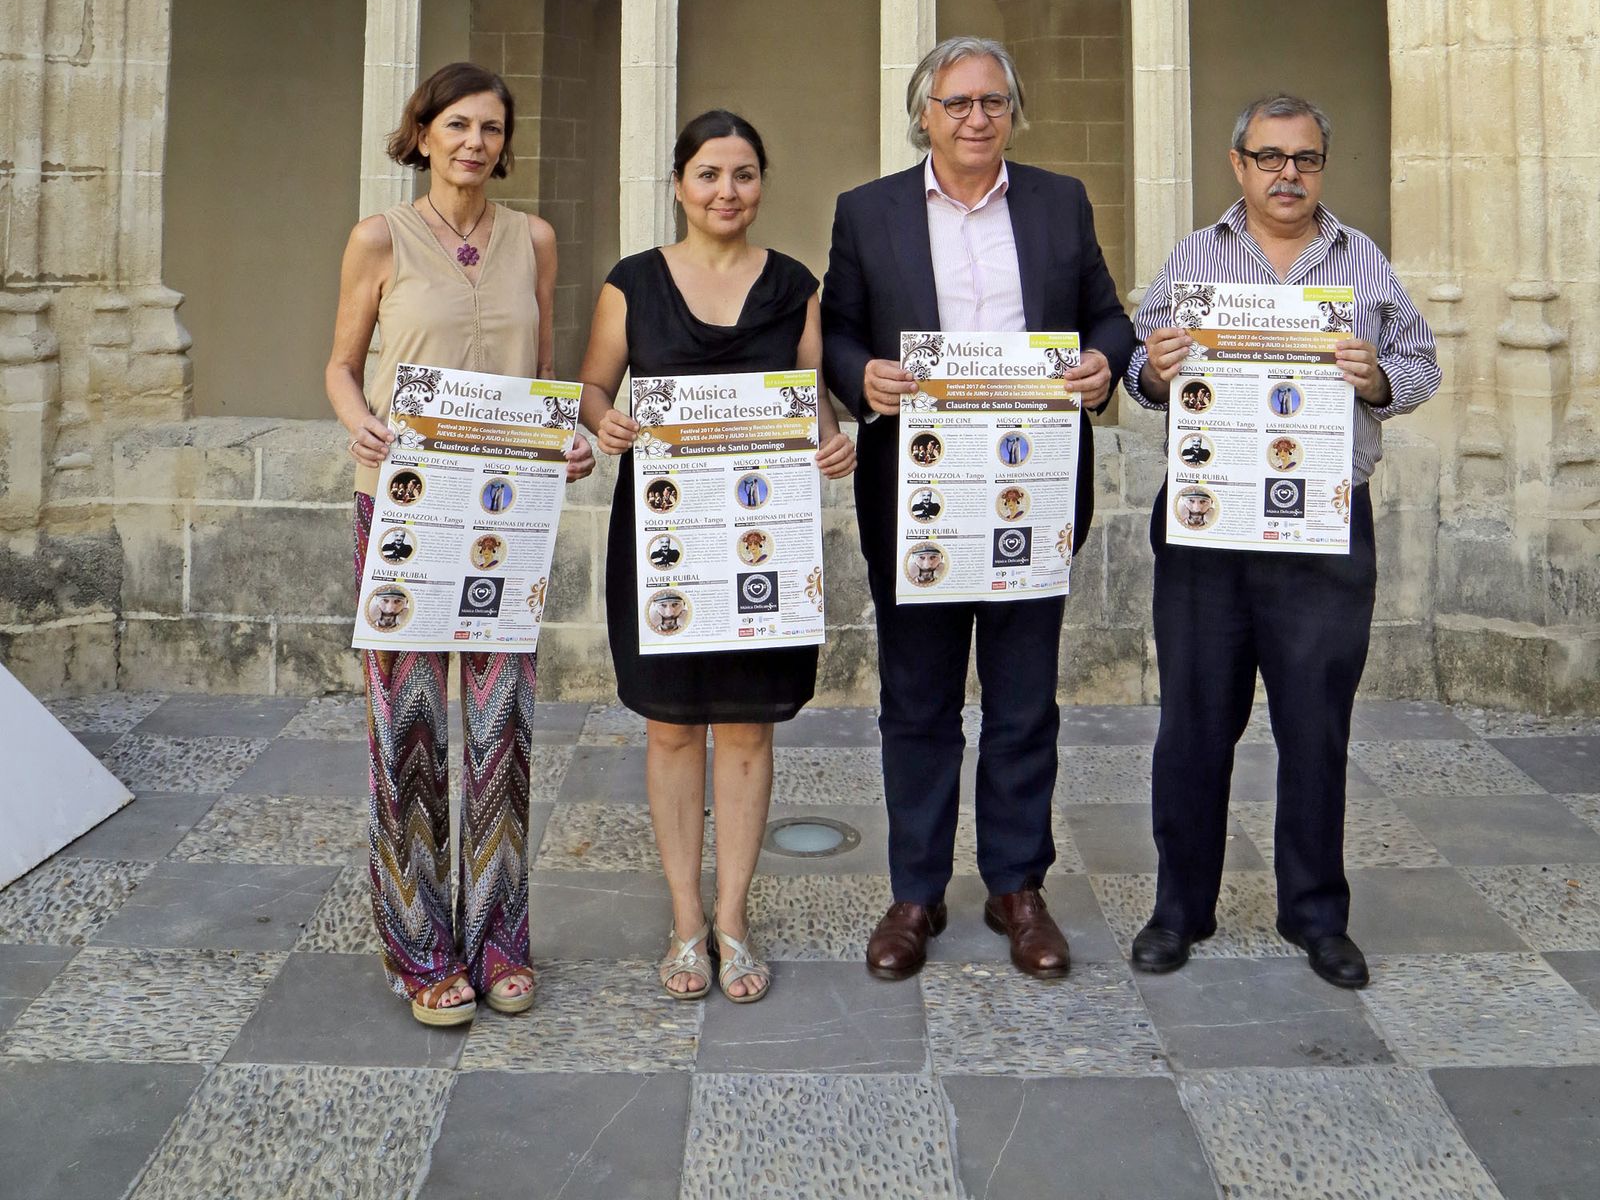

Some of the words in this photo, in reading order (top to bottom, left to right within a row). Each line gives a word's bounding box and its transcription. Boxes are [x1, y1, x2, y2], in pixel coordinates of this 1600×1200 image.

[1218, 294, 1276, 309] Música
[1218, 312, 1320, 329] Delicatessen
[947, 343, 1003, 357] Música
[1217, 351, 1251, 359] Claustros
[1263, 352, 1285, 360] Santo
[1286, 353, 1321, 363] Domingo
[947, 361, 1047, 377] Delicatessen
[442, 380, 503, 401] Música
[678, 384, 737, 402] Música
[439, 400, 544, 425] Delicatessen
[680, 401, 783, 421] Delicatessen
[1015, 402, 1048, 410] Domingo
[1236, 421, 1255, 429] Tango
[433, 441, 470, 452] Claustros
[470, 444, 481, 453] de
[482, 445, 503, 455] Santo
[504, 447, 539, 460] Domingo
[680, 445, 715, 454] Claustros
[716, 444, 726, 452] de
[728, 443, 749, 451] Santo
[751, 441, 785, 451] Domingo
[530, 466, 556, 474] Gabarre
[1202, 473, 1229, 481] RUIBAL
[403, 512, 439, 521] PIAZZOLA
[932, 527, 959, 535] RUIBAL
[372, 569, 399, 577] JAVIER
[400, 571, 429, 579] RUIBAL
[646, 575, 671, 583] JAVIER
[673, 574, 700, 582] RUIBAL
